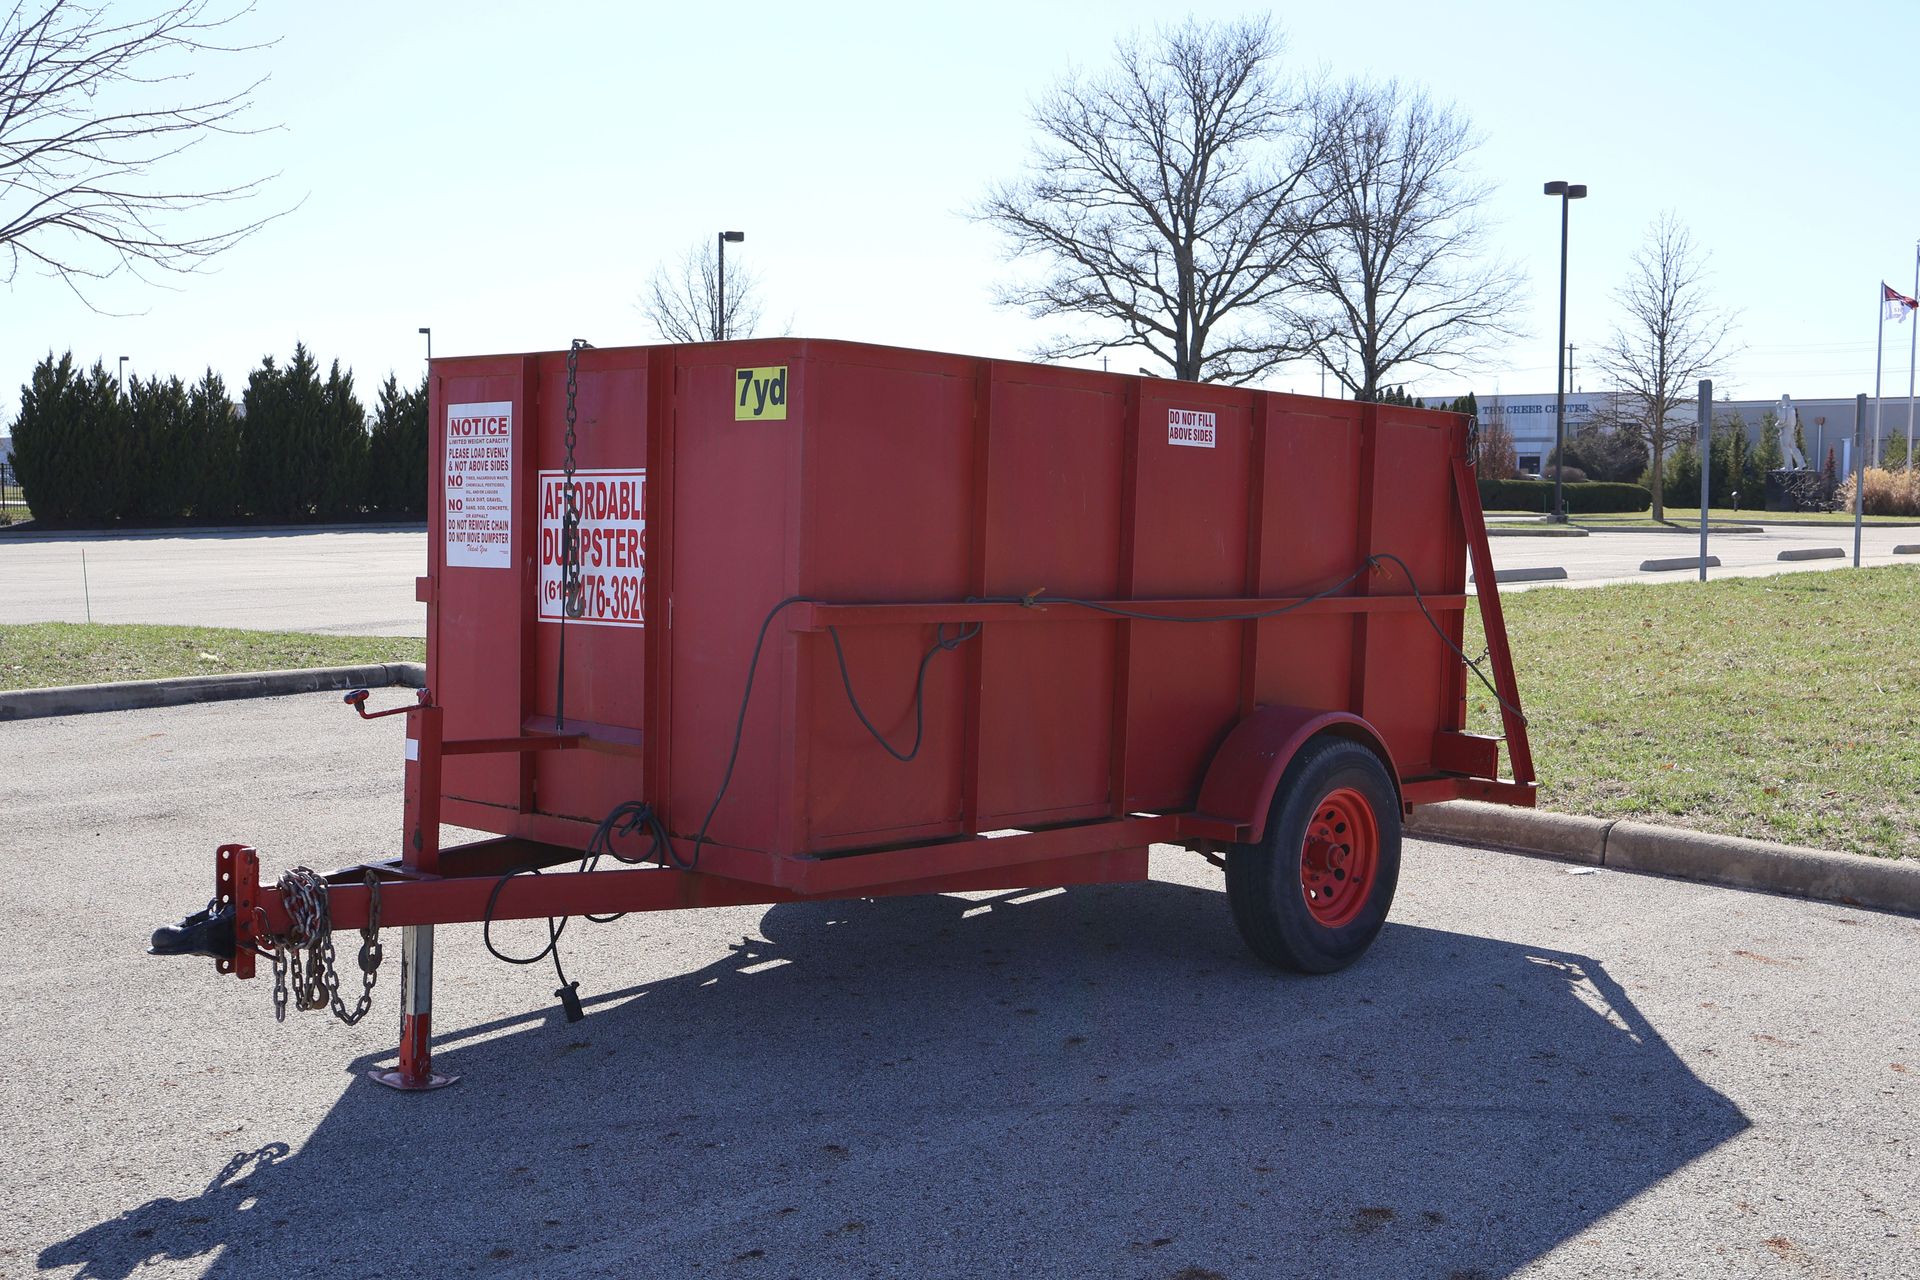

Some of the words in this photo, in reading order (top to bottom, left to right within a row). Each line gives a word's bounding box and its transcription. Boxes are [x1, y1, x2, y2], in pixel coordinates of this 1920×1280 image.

[738, 368, 786, 416] 7yd
[1483, 406, 1504, 414] THE
[1506, 405, 1542, 414] CHEER
[1170, 411, 1180, 424] DO
[1182, 412, 1196, 426] NOT
[1198, 413, 1213, 427] FILL
[451, 417, 507, 436] NOTICE
[1170, 427, 1192, 440] ABOVE
[1193, 429, 1213, 442] SIDES
[449, 448, 470, 458] PLEASE
[471, 447, 485, 458] LOAD
[487, 447, 509, 458] EVENLY
[448, 461, 453, 471] &
[455, 460, 467, 471] NOT
[469, 460, 489, 471] ABOVE
[490, 460, 509, 471] SIDES
[448, 475, 463, 486] NO
[448, 499, 463, 510] NO
[448, 520, 456, 530] DO
[457, 520, 467, 530] NOT
[468, 520, 490, 531] REMOVE
[491, 520, 509, 531] CHAIN
[448, 532, 455, 542] DO
[456, 532, 466, 542] NOT
[467, 533, 481, 543] MOVE
[481, 533, 509, 544] DUMPSTER
[543, 527, 646, 569] DUPSTERS
